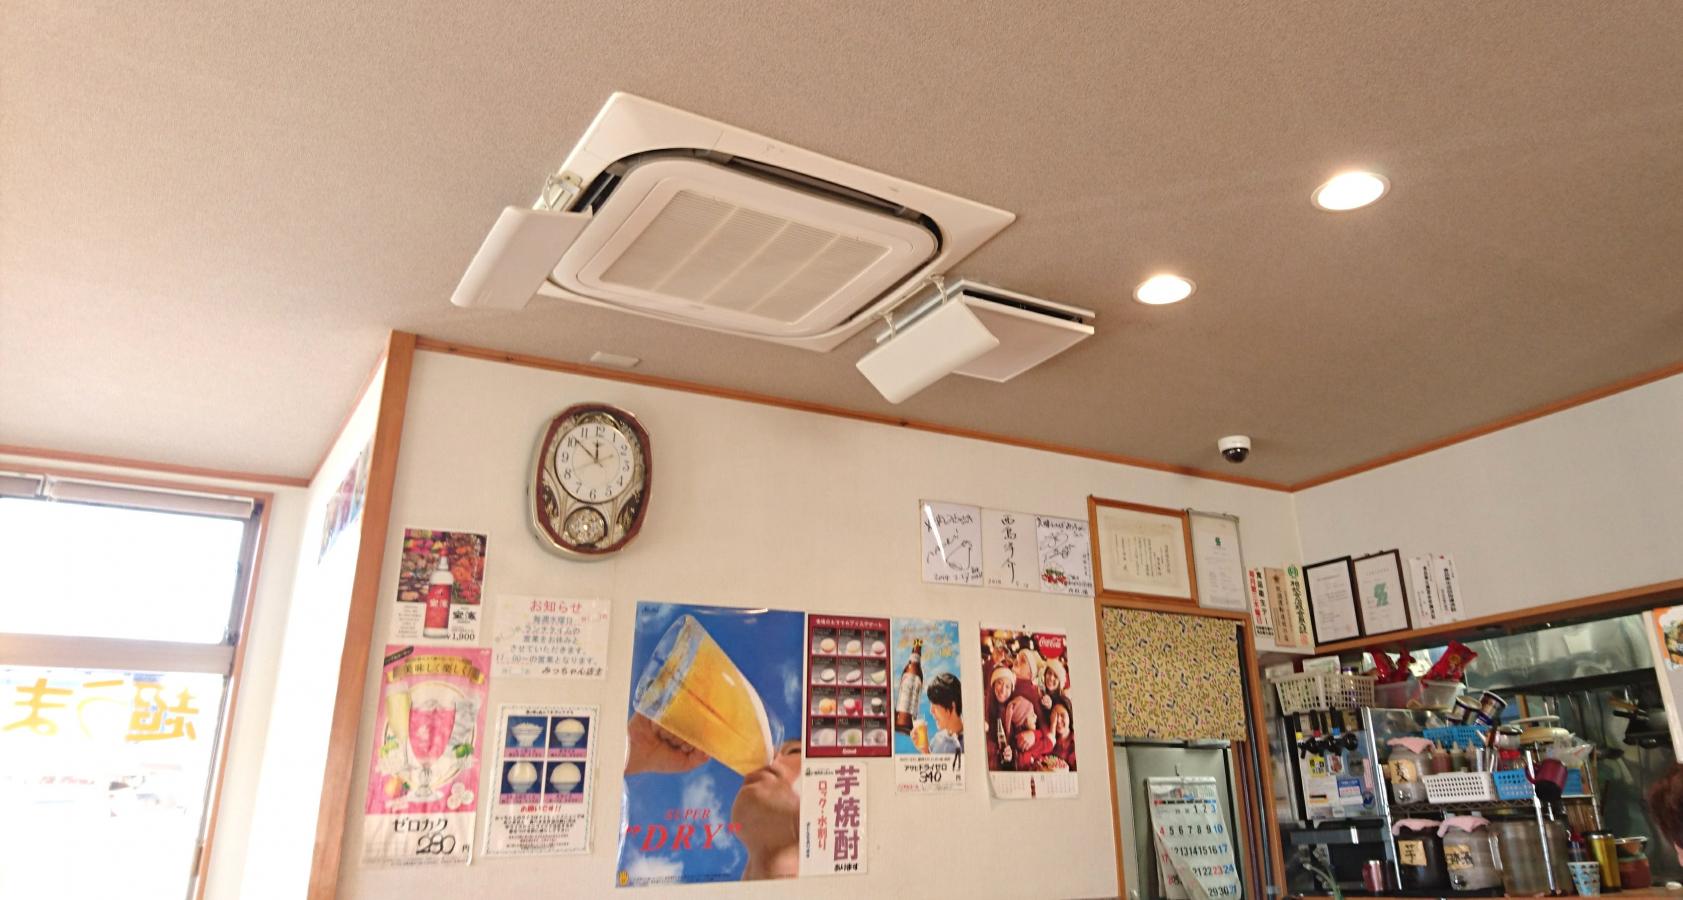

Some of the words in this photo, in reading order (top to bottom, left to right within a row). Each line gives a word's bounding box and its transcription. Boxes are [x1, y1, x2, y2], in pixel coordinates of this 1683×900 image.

[581, 427, 588, 439] 11
[596, 425, 605, 438] 12
[612, 432, 617, 443] 1
[567, 436, 577, 448] 10
[620, 445, 628, 456] 2
[561, 451, 569, 463] 9
[622, 461, 630, 472] 3
[564, 469, 572, 480] 8
[617, 476, 624, 487] 4
[576, 482, 583, 494] 7
[605, 486, 612, 497] 5
[589, 489, 597, 500] 6
[530, 600, 582, 614] お知らせ
[664, 807, 712, 820] SUPER
[817, 780, 828, 850] ロック・水割り
[834, 765, 860, 862] 芋焼酎
[1193, 804, 1199, 814] 1
[1203, 804, 1208, 813] 2
[1211, 804, 1217, 813] 3
[393, 817, 448, 832] ゼロカク
[1159, 826, 1165, 836] 4
[1169, 825, 1175, 836] 5
[1178, 826, 1184, 836] 6
[1187, 825, 1193, 835] 7
[1197, 825, 1202, 835] 8
[1206, 825, 1212, 834] 9
[1213, 824, 1223, 834] 10
[416, 832, 456, 855] 280
[1180, 847, 1189, 857] 13
[1189, 846, 1198, 856] 14
[1198, 846, 1208, 856] 15
[1208, 845, 1218, 855] 16
[1218, 844, 1228, 854] 17
[1202, 866, 1212, 876] 22
[1212, 865, 1223, 876] 23
[1223, 864, 1235, 875] 24
[1218, 886, 1229, 896] 30
